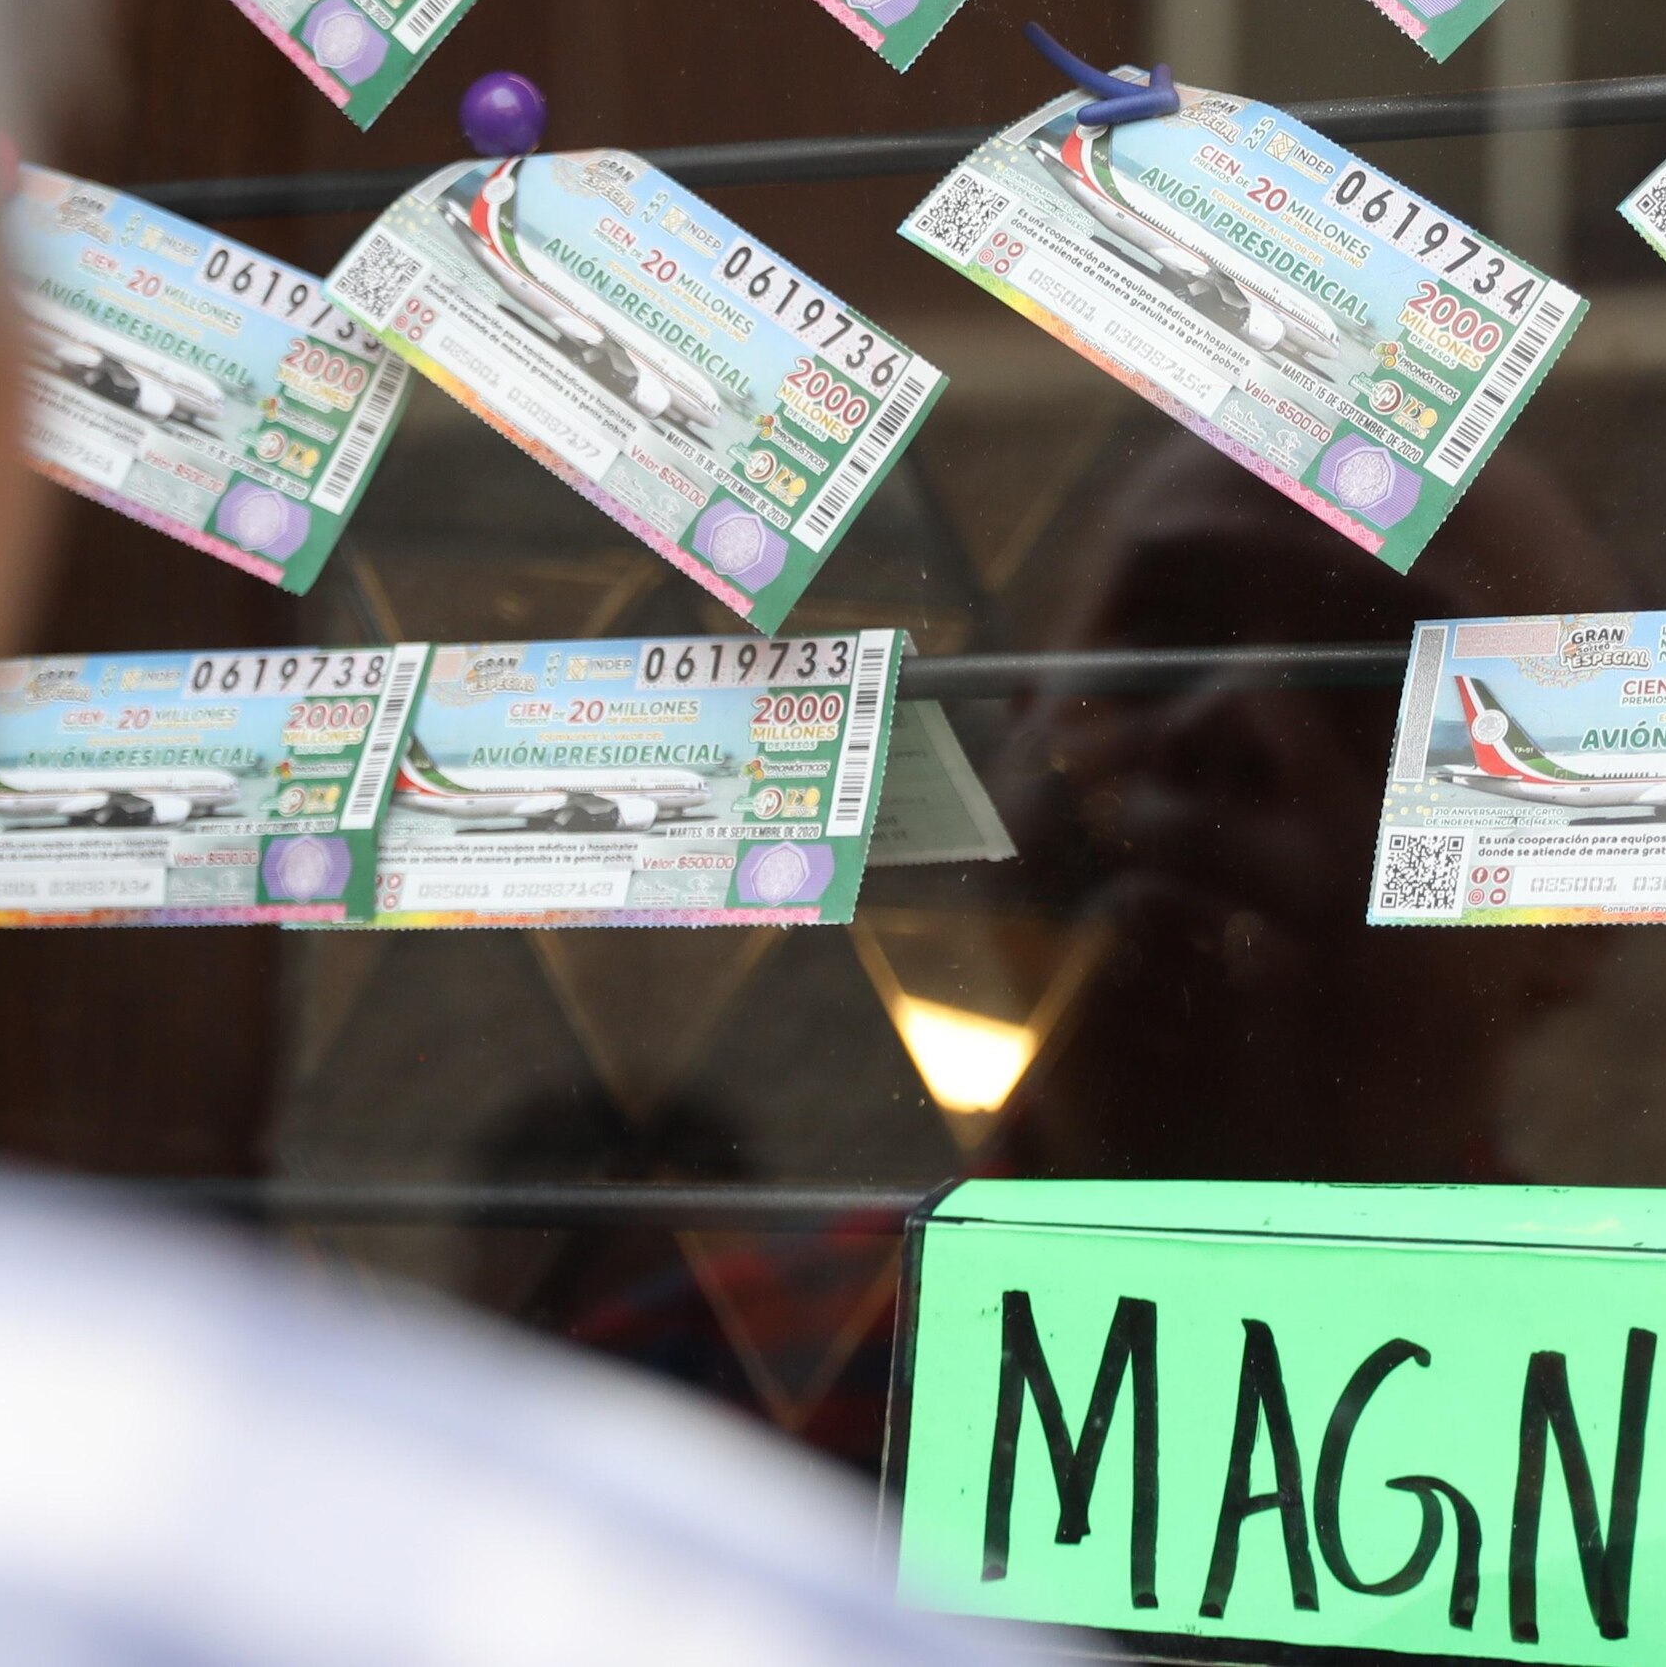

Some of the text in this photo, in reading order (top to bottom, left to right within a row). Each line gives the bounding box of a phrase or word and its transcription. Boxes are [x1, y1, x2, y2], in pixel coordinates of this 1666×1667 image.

[1198, 143, 1372, 260] CIEN 20 MILLONES
[1138, 166, 1369, 327] AVIÓN PRESIDENCIAL
[1334, 169, 1536, 315] 0619734
[598, 215, 754, 334] CIEN 20 MILLONES
[1043, 224, 1099, 268] cooperación
[1097, 260, 1120, 279] para
[1119, 275, 1158, 303] equipos
[1156, 300, 1194, 329] médicos
[1201, 328, 1252, 368] hospitales
[542, 236, 750, 398] AVIÓN PRESIDENCIAL
[722, 245, 899, 387] 0619736
[1400, 311, 1484, 371] MILLONES
[1409, 283, 1500, 353] 2000
[282, 339, 366, 395] 2000
[785, 357, 868, 427] 2000
[776, 384, 853, 444] MILLONES
[1243, 377, 1334, 450] Valor $500.00
[1279, 362, 1316, 392] MARTES
[1323, 391, 1340, 408] DE
[1336, 399, 1388, 445] SEPTIEMBRE
[1383, 431, 1400, 449] DE
[1395, 439, 1421, 462] 2020
[643, 640, 850, 682] 0619733
[1570, 653, 1648, 670] ESPECIAL
[1571, 628, 1625, 644] GRAN
[190, 653, 387, 692] 0619738
[286, 702, 372, 730] 2000
[509, 698, 698, 724] CIEN 20 MILLONES
[750, 725, 838, 740] MILLONES
[752, 694, 843, 724] 2000
[469, 739, 722, 765] AVIÓN PRESIDENCIAL
